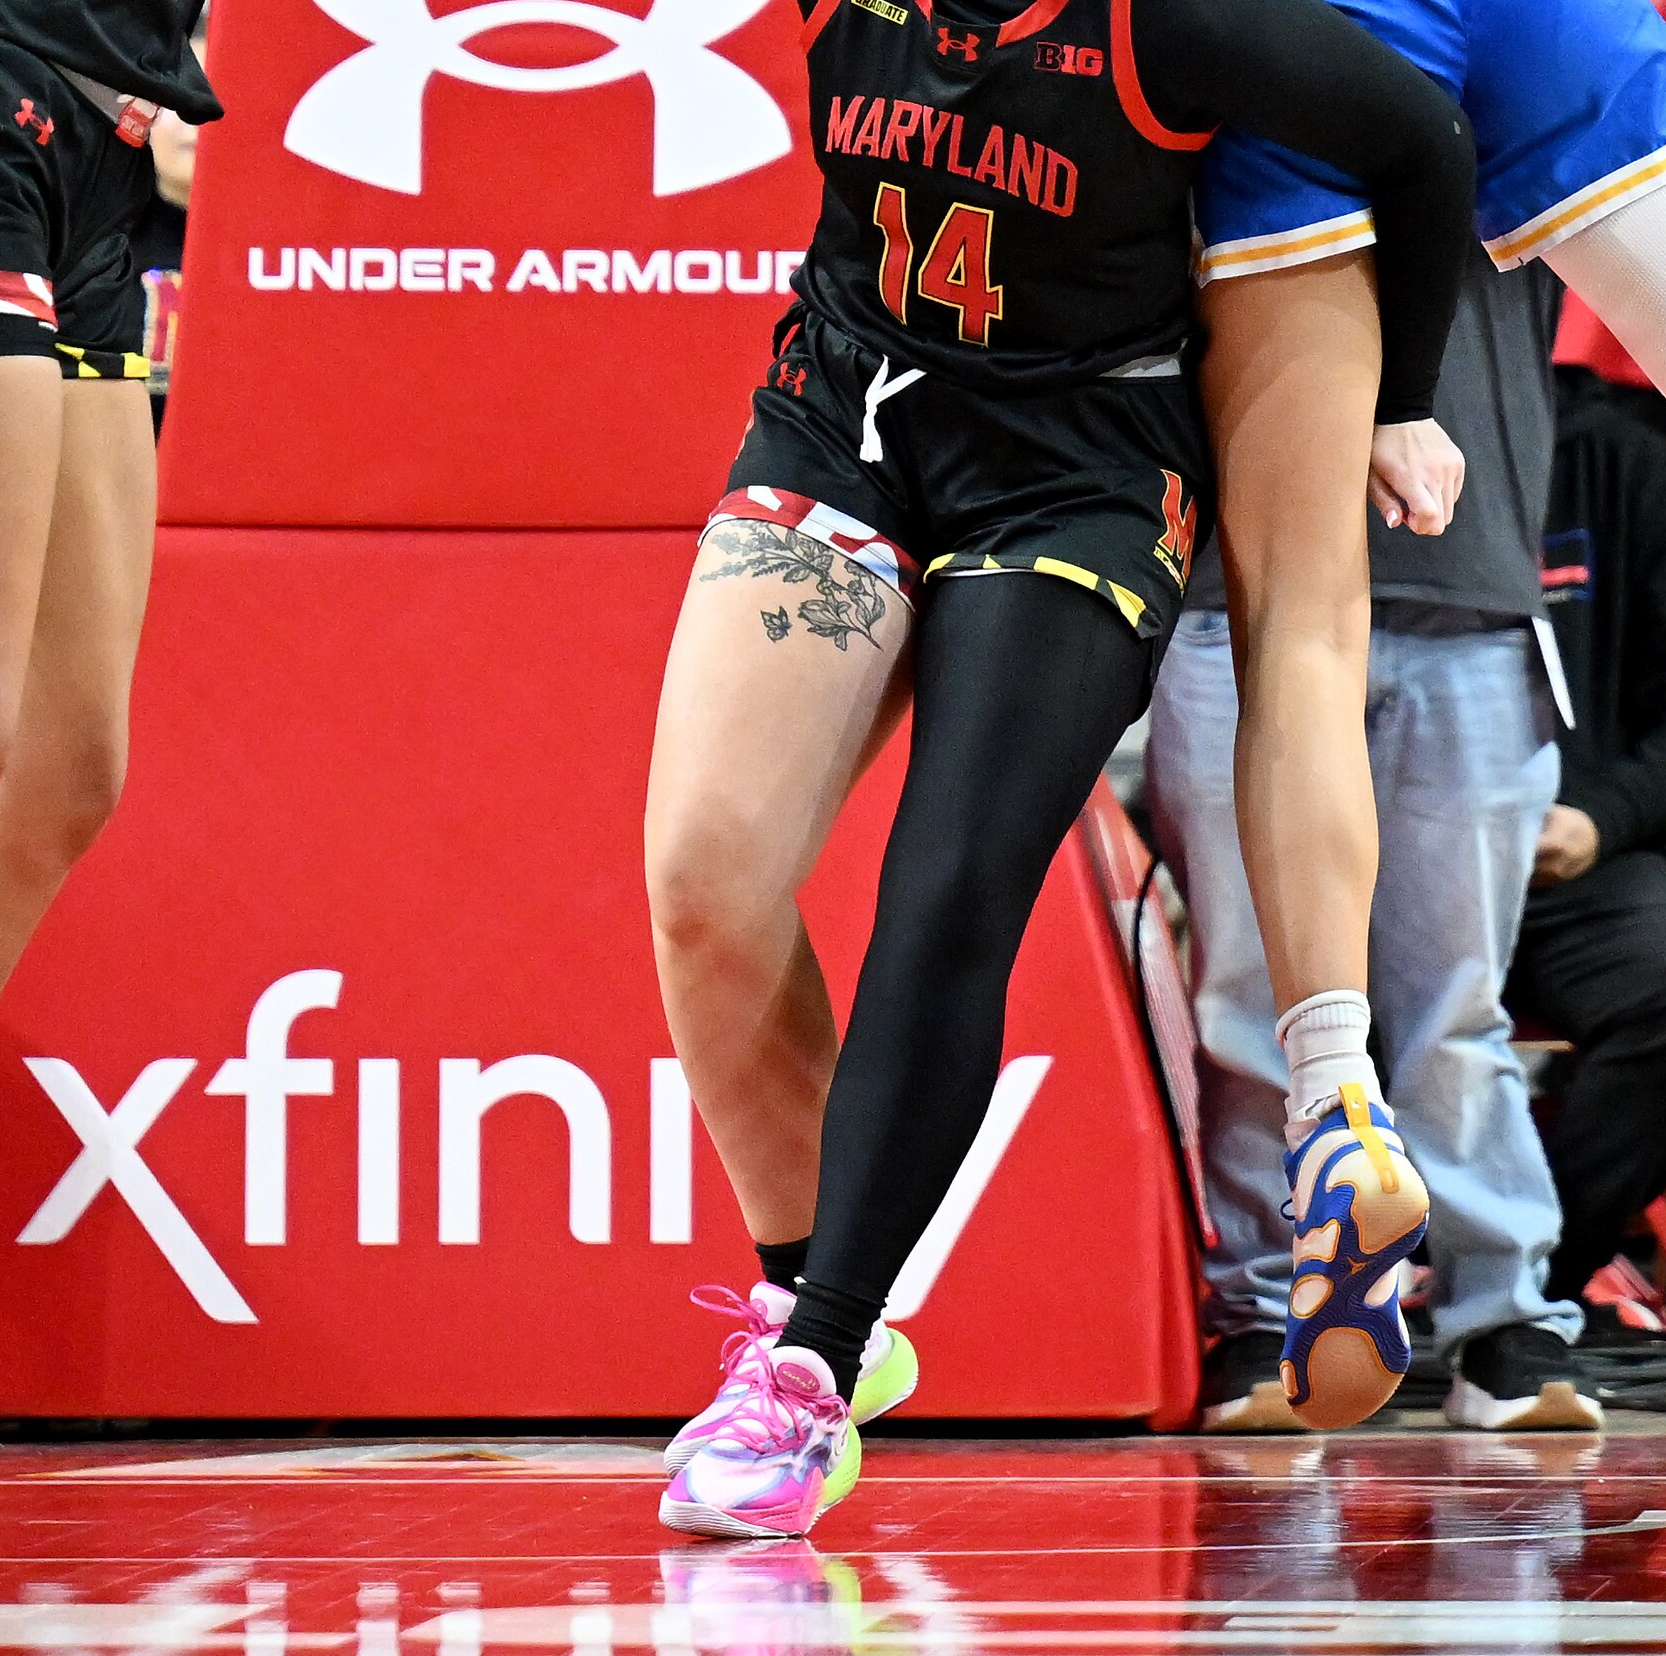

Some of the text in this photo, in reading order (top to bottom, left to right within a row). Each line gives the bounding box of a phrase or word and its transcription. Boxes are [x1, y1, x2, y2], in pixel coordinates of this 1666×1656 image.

[825, 95, 1079, 218] MARYLAND
[247, 247, 496, 292] UNDER
[873, 181, 1003, 348] 14
[15, 968, 1051, 1324] xfiniy
